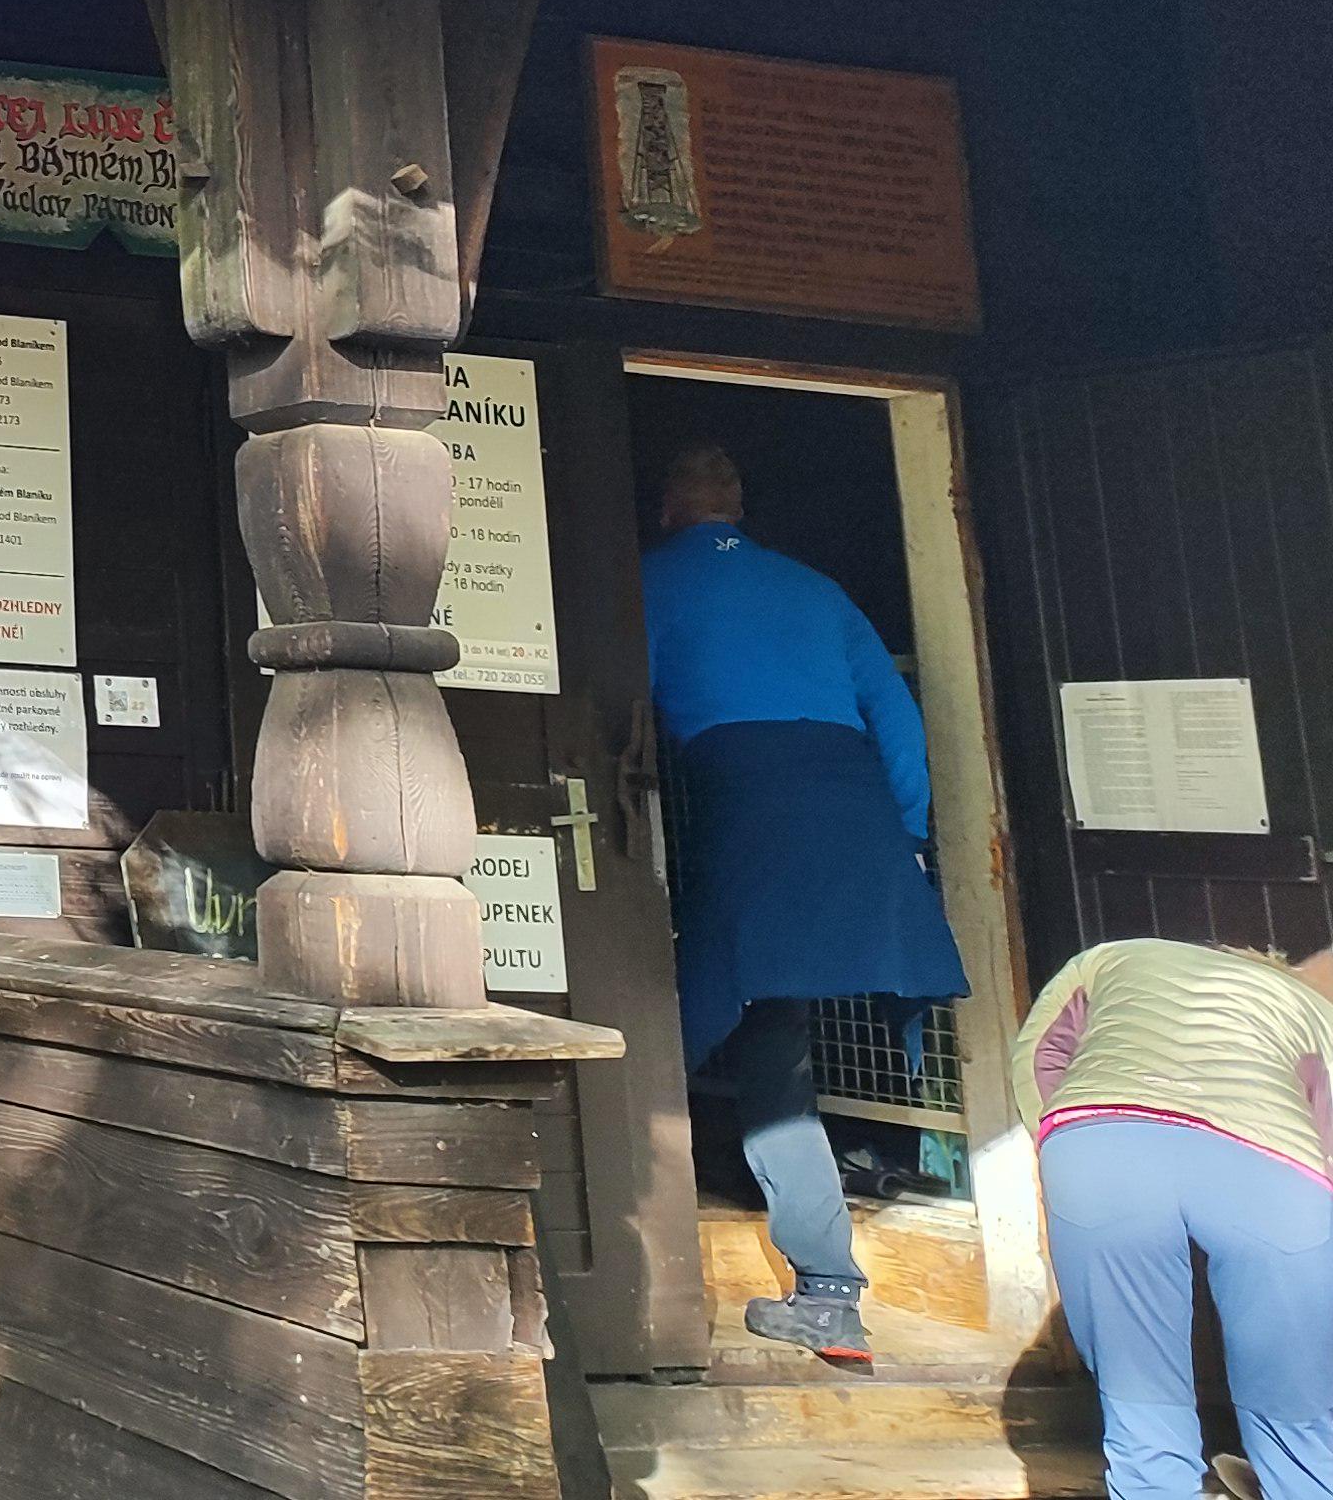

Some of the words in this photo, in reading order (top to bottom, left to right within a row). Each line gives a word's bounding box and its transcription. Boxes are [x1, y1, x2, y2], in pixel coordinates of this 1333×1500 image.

[10, 339, 56, 352] Blaníkem
[10, 376, 54, 389] Blaníkem
[437, 396, 526, 428] ANÍKU
[469, 476, 483, 490] 17
[487, 477, 522, 493] hodin
[16, 488, 53, 501] Blaníku
[459, 494, 504, 509] pondělí
[13, 511, 57, 524] Blaníkem
[471, 528, 485, 541] 18
[488, 529, 521, 543] hodin
[464, 564, 471, 573] a
[475, 562, 513, 579] svátky
[471, 578, 505, 593] hodin
[477, 669, 498, 682] 720
[29, 687, 66, 701] obsluhy
[16, 705, 61, 717] parkovné
